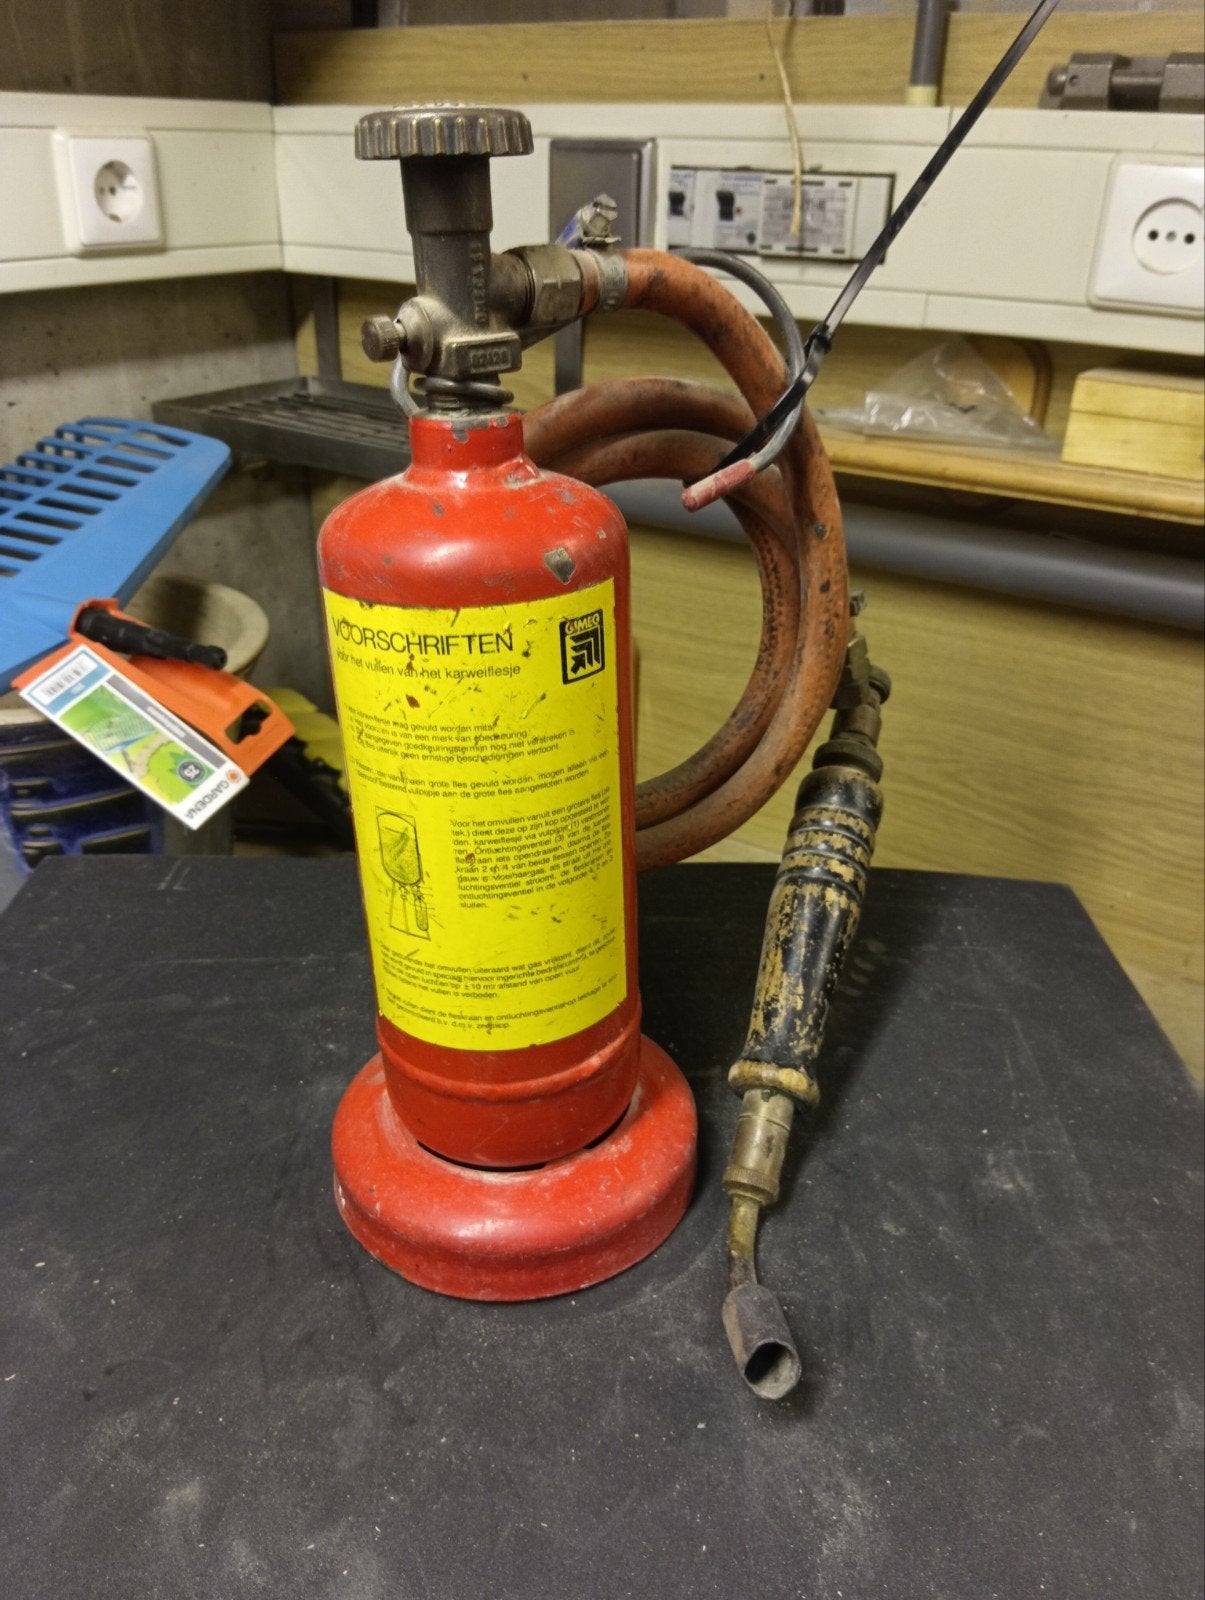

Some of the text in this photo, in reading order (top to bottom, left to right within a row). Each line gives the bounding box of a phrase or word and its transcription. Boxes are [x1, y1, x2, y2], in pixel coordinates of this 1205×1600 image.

[332, 616, 513, 656] VOORSCHRIFTEN
[365, 659, 394, 675] vullen
[397, 666, 418, 677] van
[421, 668, 441, 679] het
[446, 665, 521, 679] karweiflesje
[411, 723, 437, 733] gevuld
[440, 725, 472, 733] worden
[490, 743, 507, 751] nog
[509, 740, 524, 749] niet
[421, 754, 455, 764] ernstige
[428, 779, 450, 789] grote
[452, 780, 468, 788] fles
[470, 780, 499, 789] gevuld
[538, 767, 565, 780] mogen
[184, 779, 230, 819] GARDENA
[474, 789, 495, 800] grote
[497, 787, 513, 796] fles
[451, 819, 470, 828] Voor
[472, 820, 486, 828] het
[487, 817, 525, 827] omvullen
[495, 827, 516, 836] deze
[517, 825, 528, 834] op
[545, 817, 559, 828] kop
[474, 835, 523, 847] karweiflesje
[474, 838, 552, 856] Ontluchtingsventiel
[458, 880, 521, 893] luchtingsventiel
[458, 886, 534, 900] ontluchtingsventiel
[545, 881, 556, 890] de
[527, 961, 542, 971] gas
[497, 970, 536, 982] ingerichte
[471, 982, 481, 990] 10
[498, 979, 528, 990] afstand
[529, 976, 544, 985] van
